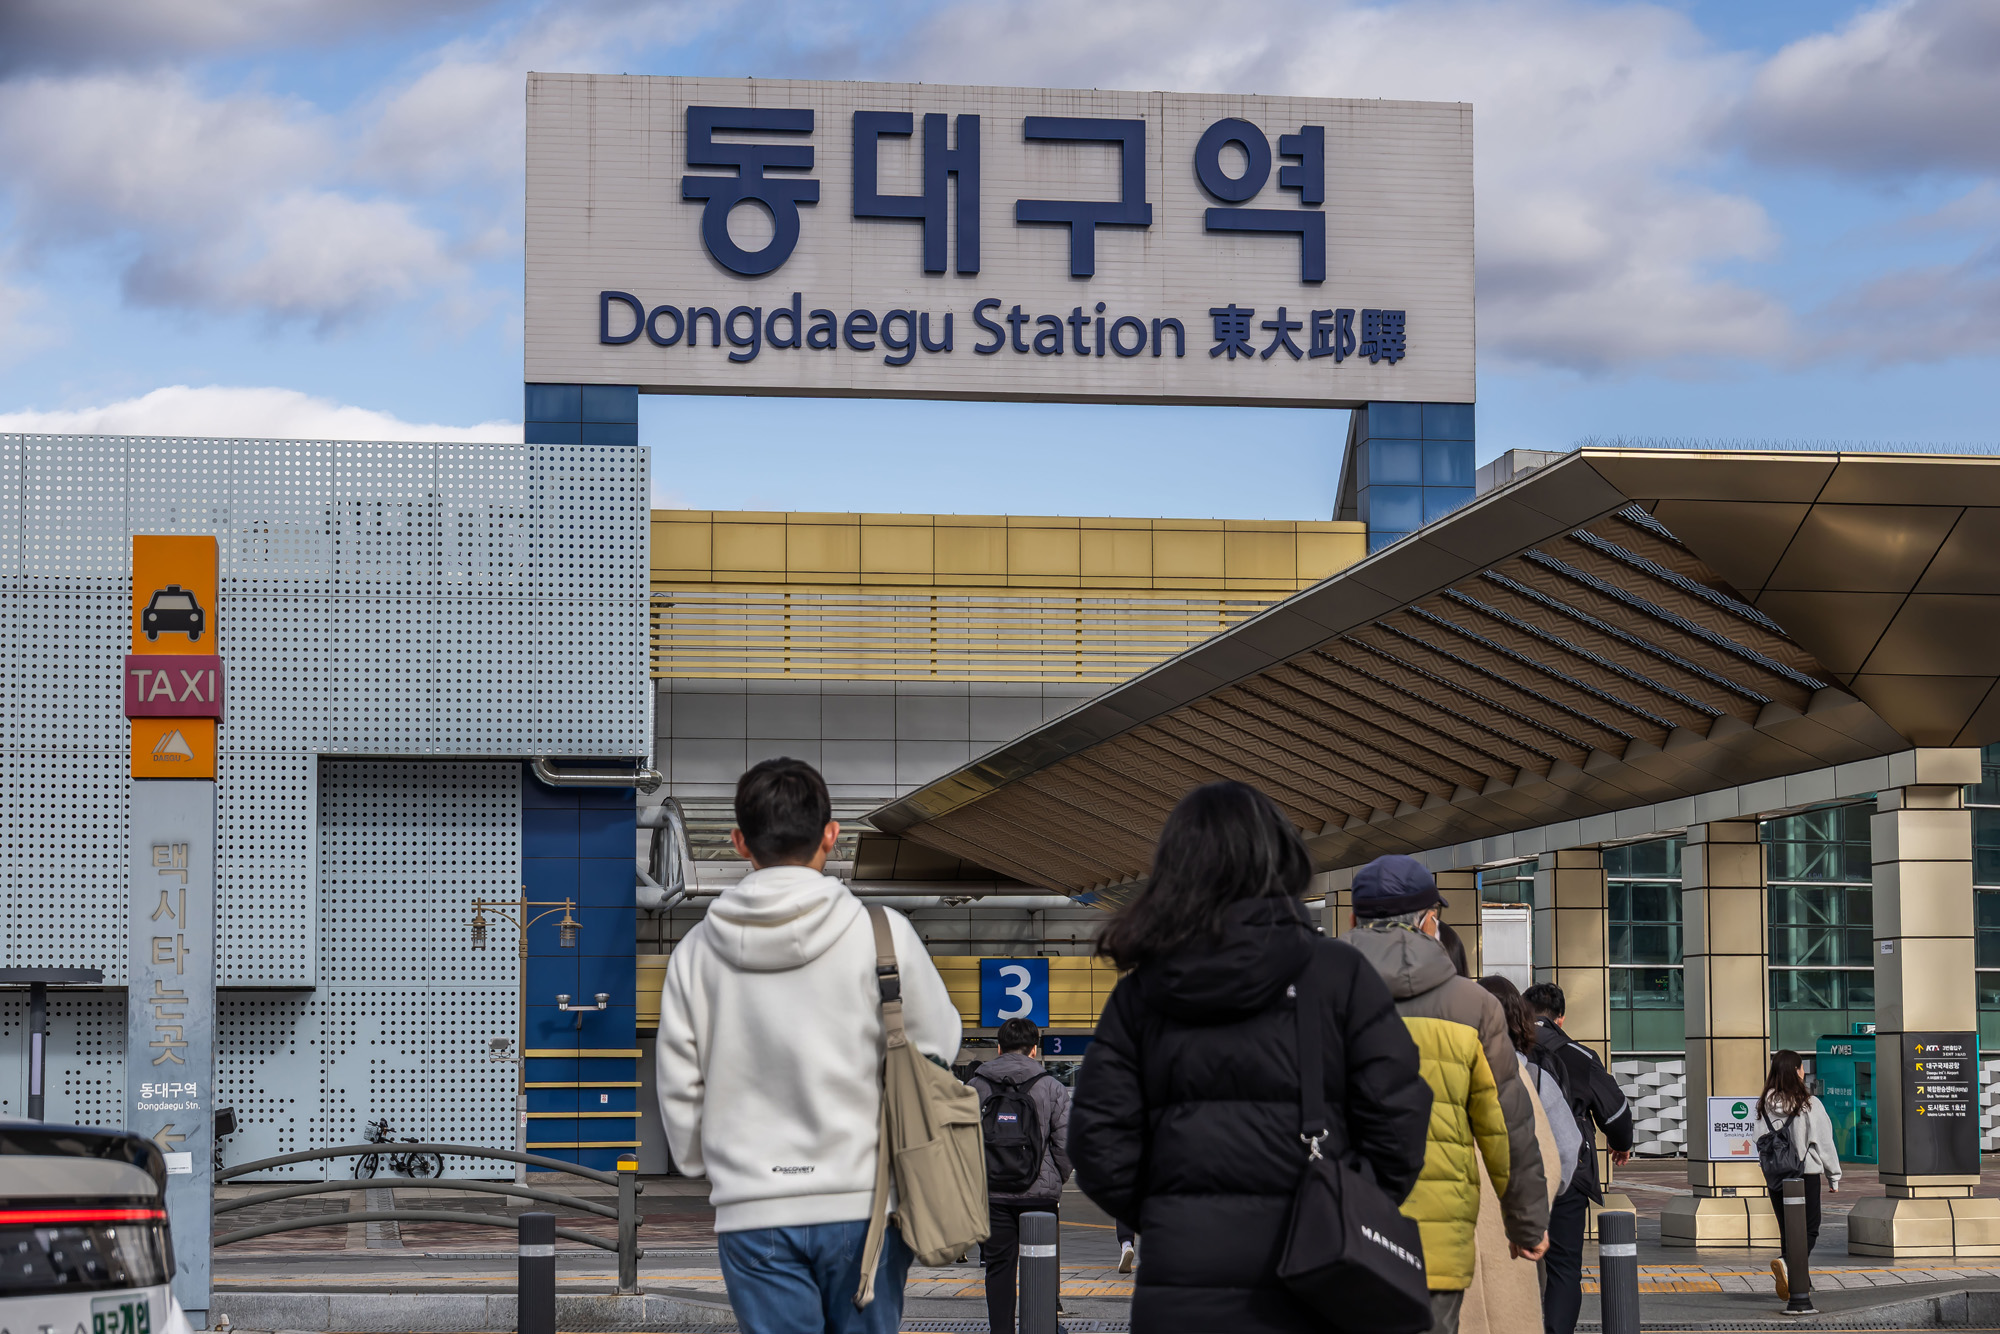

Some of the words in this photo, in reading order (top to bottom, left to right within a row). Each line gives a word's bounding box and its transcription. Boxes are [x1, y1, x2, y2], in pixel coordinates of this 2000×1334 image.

[682, 105, 1326, 283] 동대구역
[600, 290, 953, 365] Dongdaegu
[973, 298, 1185, 358] Station
[1209, 303, 1407, 364] 東大邱驛
[130, 669, 215, 703] TAXI
[153, 754, 181, 763] DAEGU
[997, 964, 1034, 1022] 3
[1053, 1037, 1062, 1054] 3
[1926, 1062, 1960, 1070] 대구국제공항
[139, 1082, 197, 1099] 동대구역
[137, 1101, 184, 1112] Dongdaegu
[185, 1101, 201, 1110] Stn.
[1714, 1122, 1743, 1132] 흡연구역
